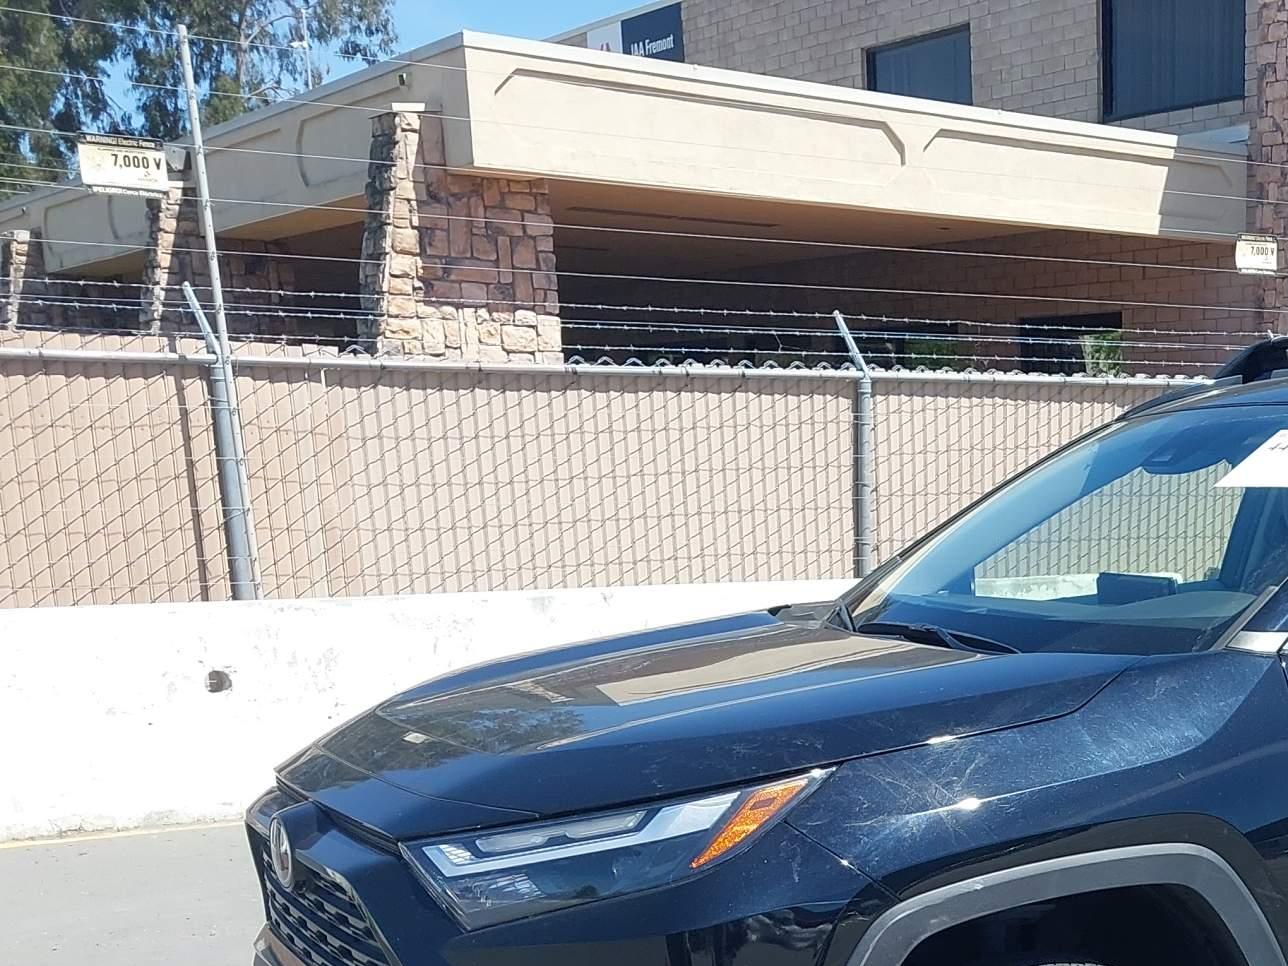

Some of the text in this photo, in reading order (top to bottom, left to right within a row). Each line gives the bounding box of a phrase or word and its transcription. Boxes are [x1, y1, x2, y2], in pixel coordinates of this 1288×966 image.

[631, 34, 674, 56] IAA Fremont
[111, 153, 161, 170] 7,000 V
[1250, 246, 1275, 256] 7,000 V
